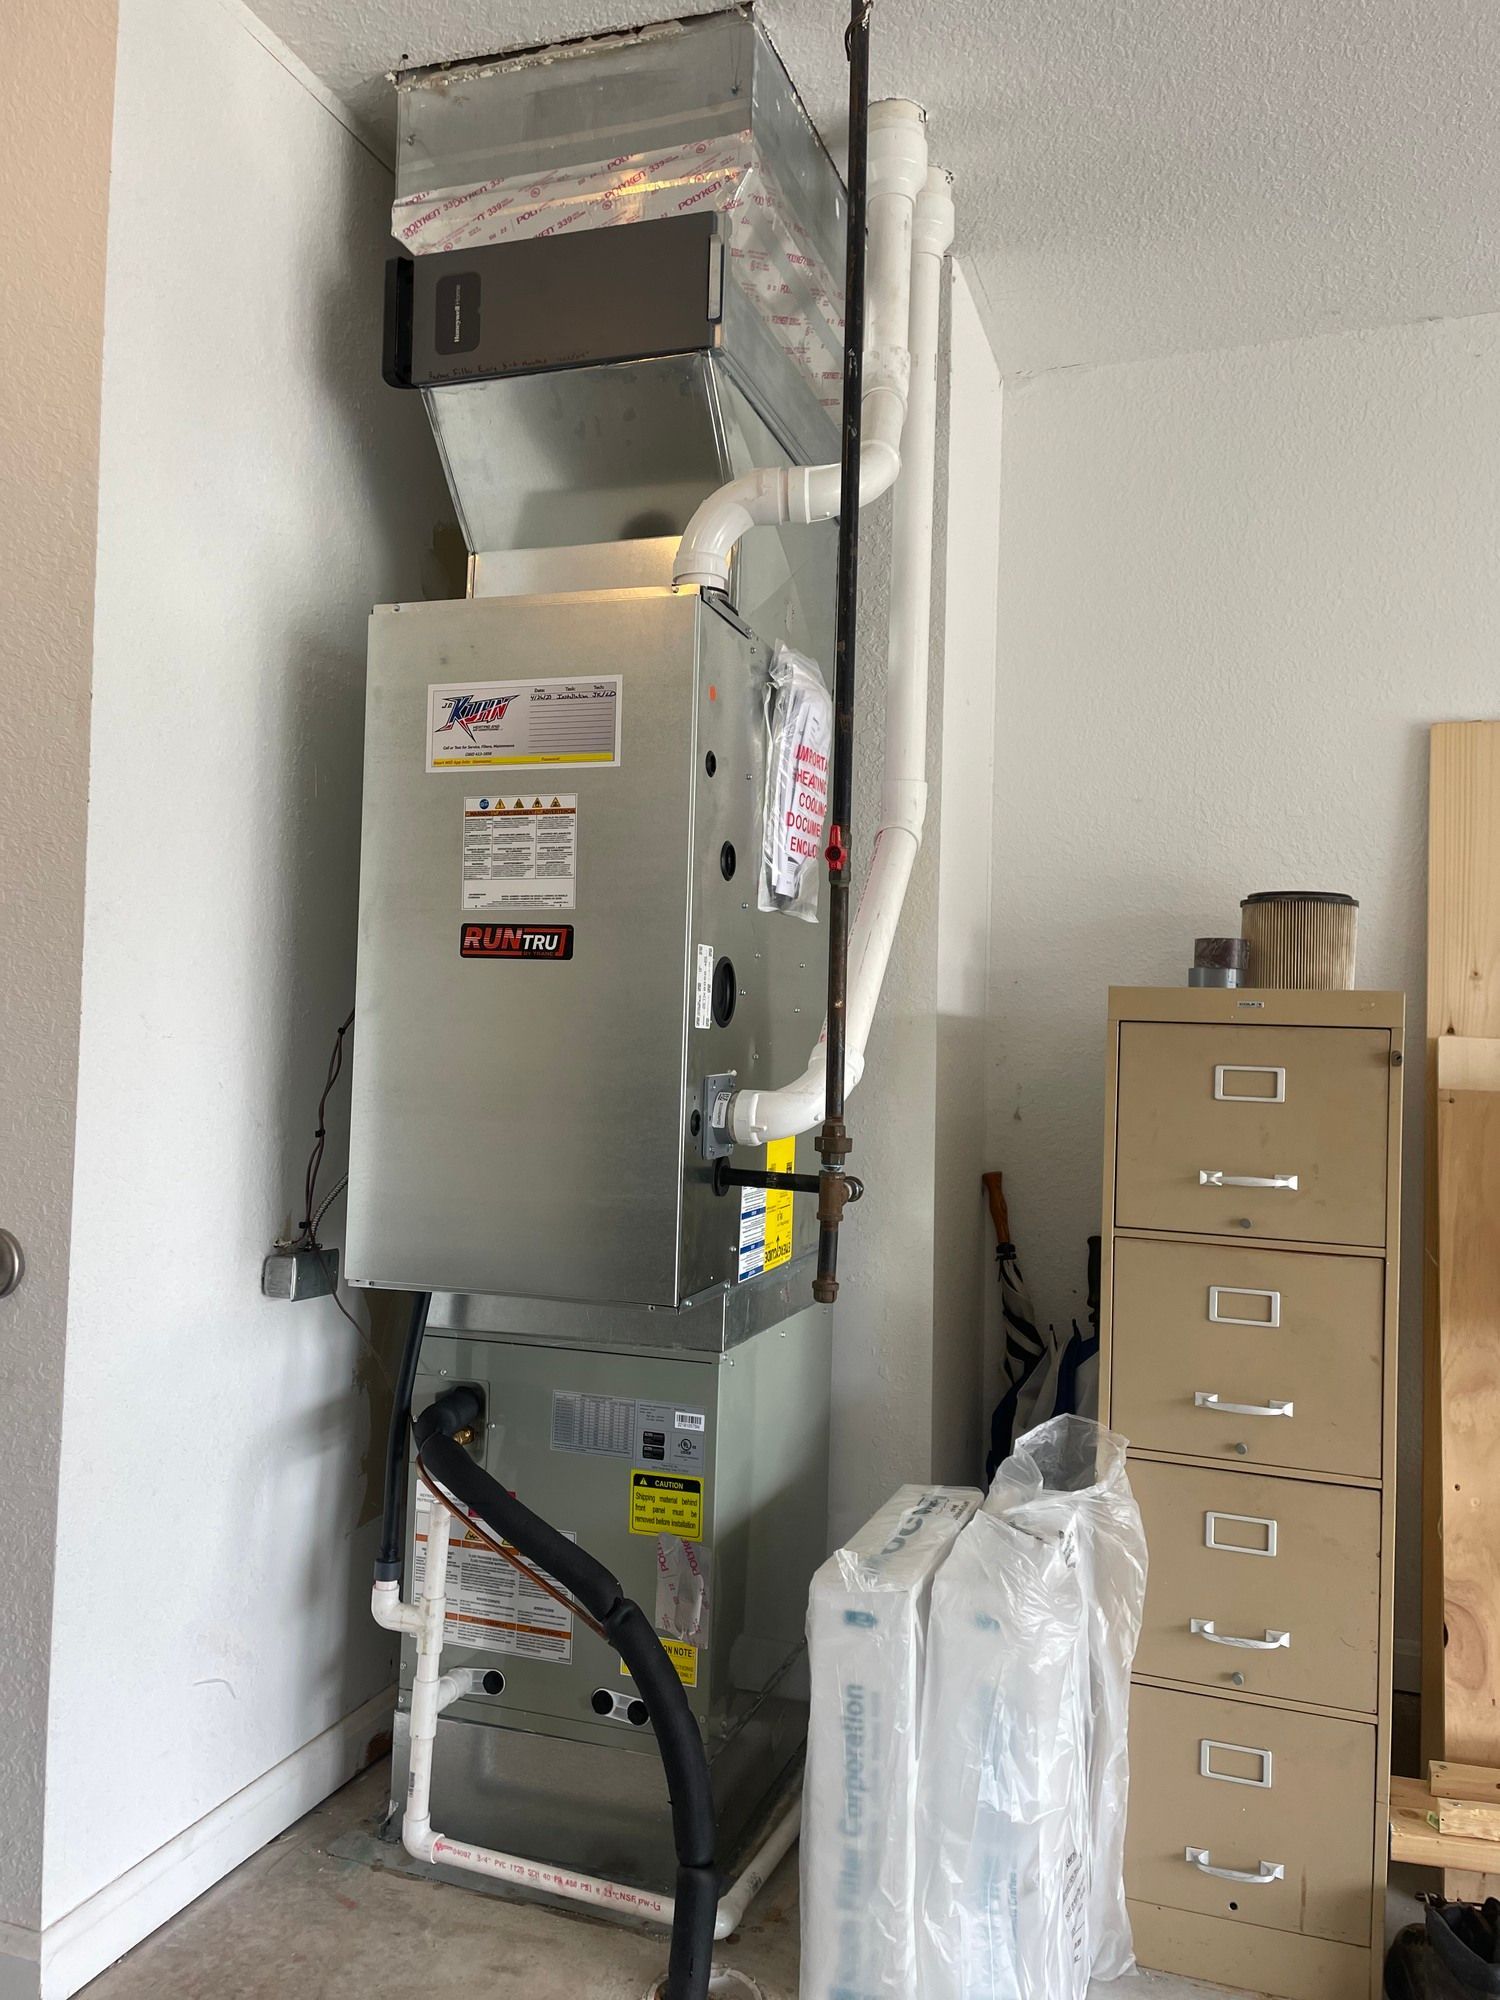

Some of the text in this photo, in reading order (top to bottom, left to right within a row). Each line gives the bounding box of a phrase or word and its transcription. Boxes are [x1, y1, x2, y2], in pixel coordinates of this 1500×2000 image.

[605, 170, 646, 198] POLYKEN
[649, 161, 664, 173] 339
[678, 181, 721, 210] POLYKEN
[558, 215, 573, 229] 339
[655, 1480, 684, 1489] CAUTION
[635, 1492, 698, 1506] Shipping material behind
[635, 1504, 646, 1512] front
[635, 1516, 696, 1529] removed before installation
[495, 1858, 507, 1869] PVC
